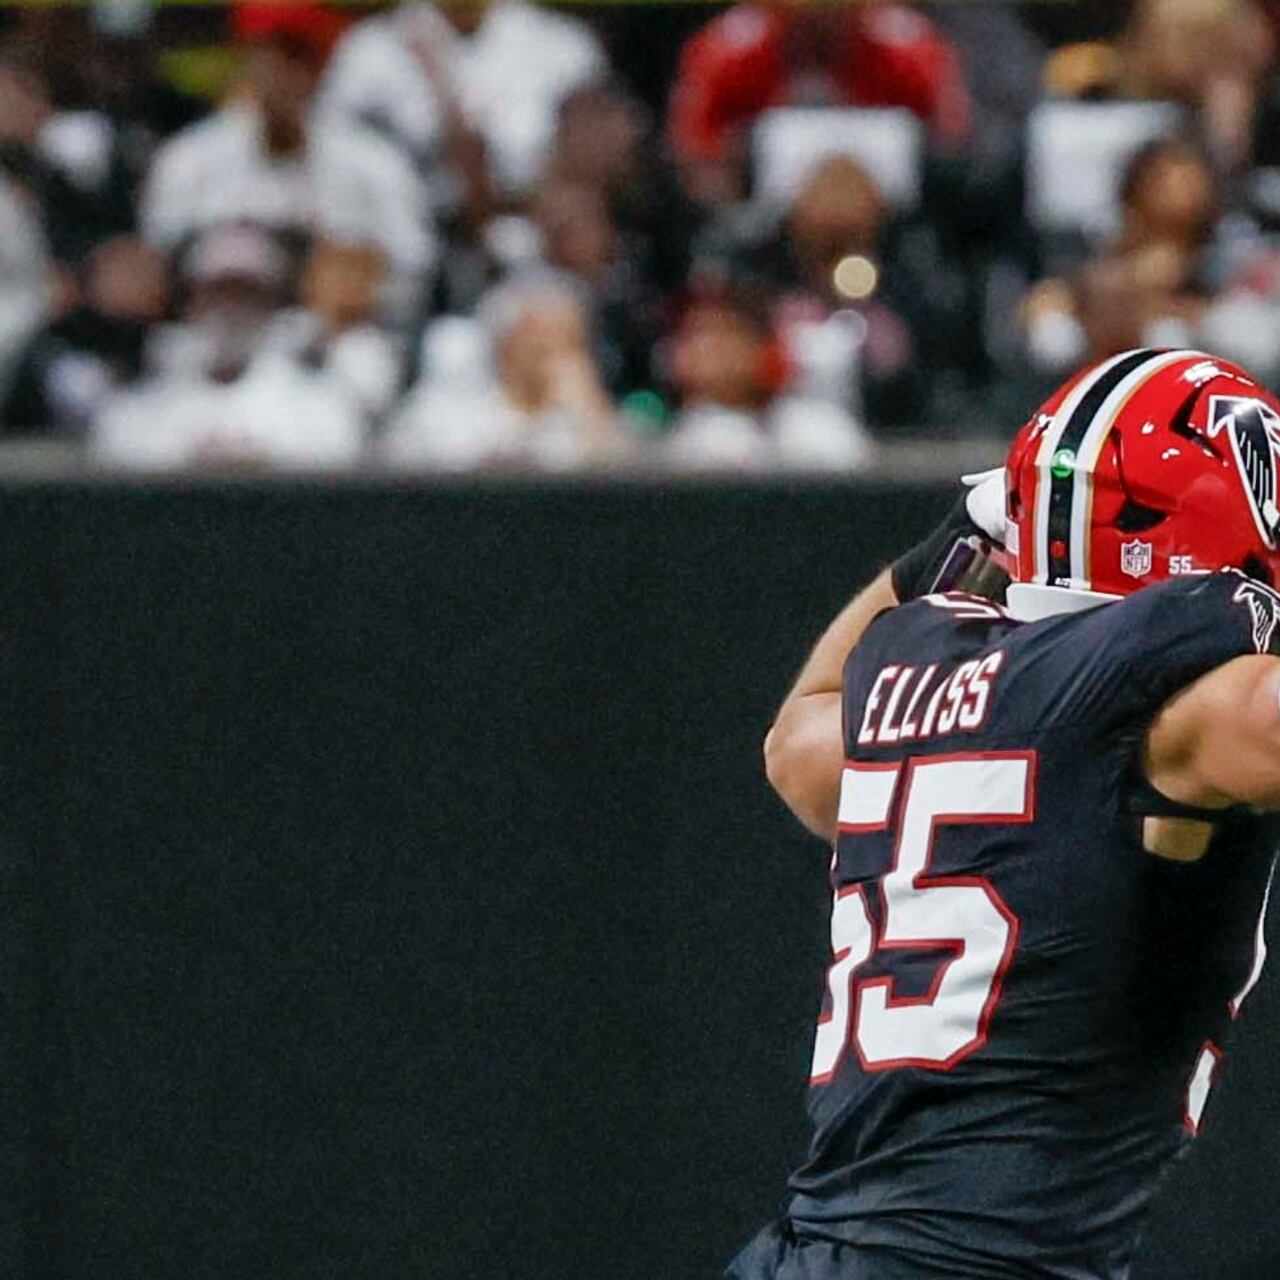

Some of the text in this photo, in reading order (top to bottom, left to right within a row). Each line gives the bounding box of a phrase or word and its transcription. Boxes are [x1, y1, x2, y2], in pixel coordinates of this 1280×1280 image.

[1168, 555, 1193, 574] 55
[856, 648, 1004, 746] ELLISS
[808, 750, 1038, 1086] 55
